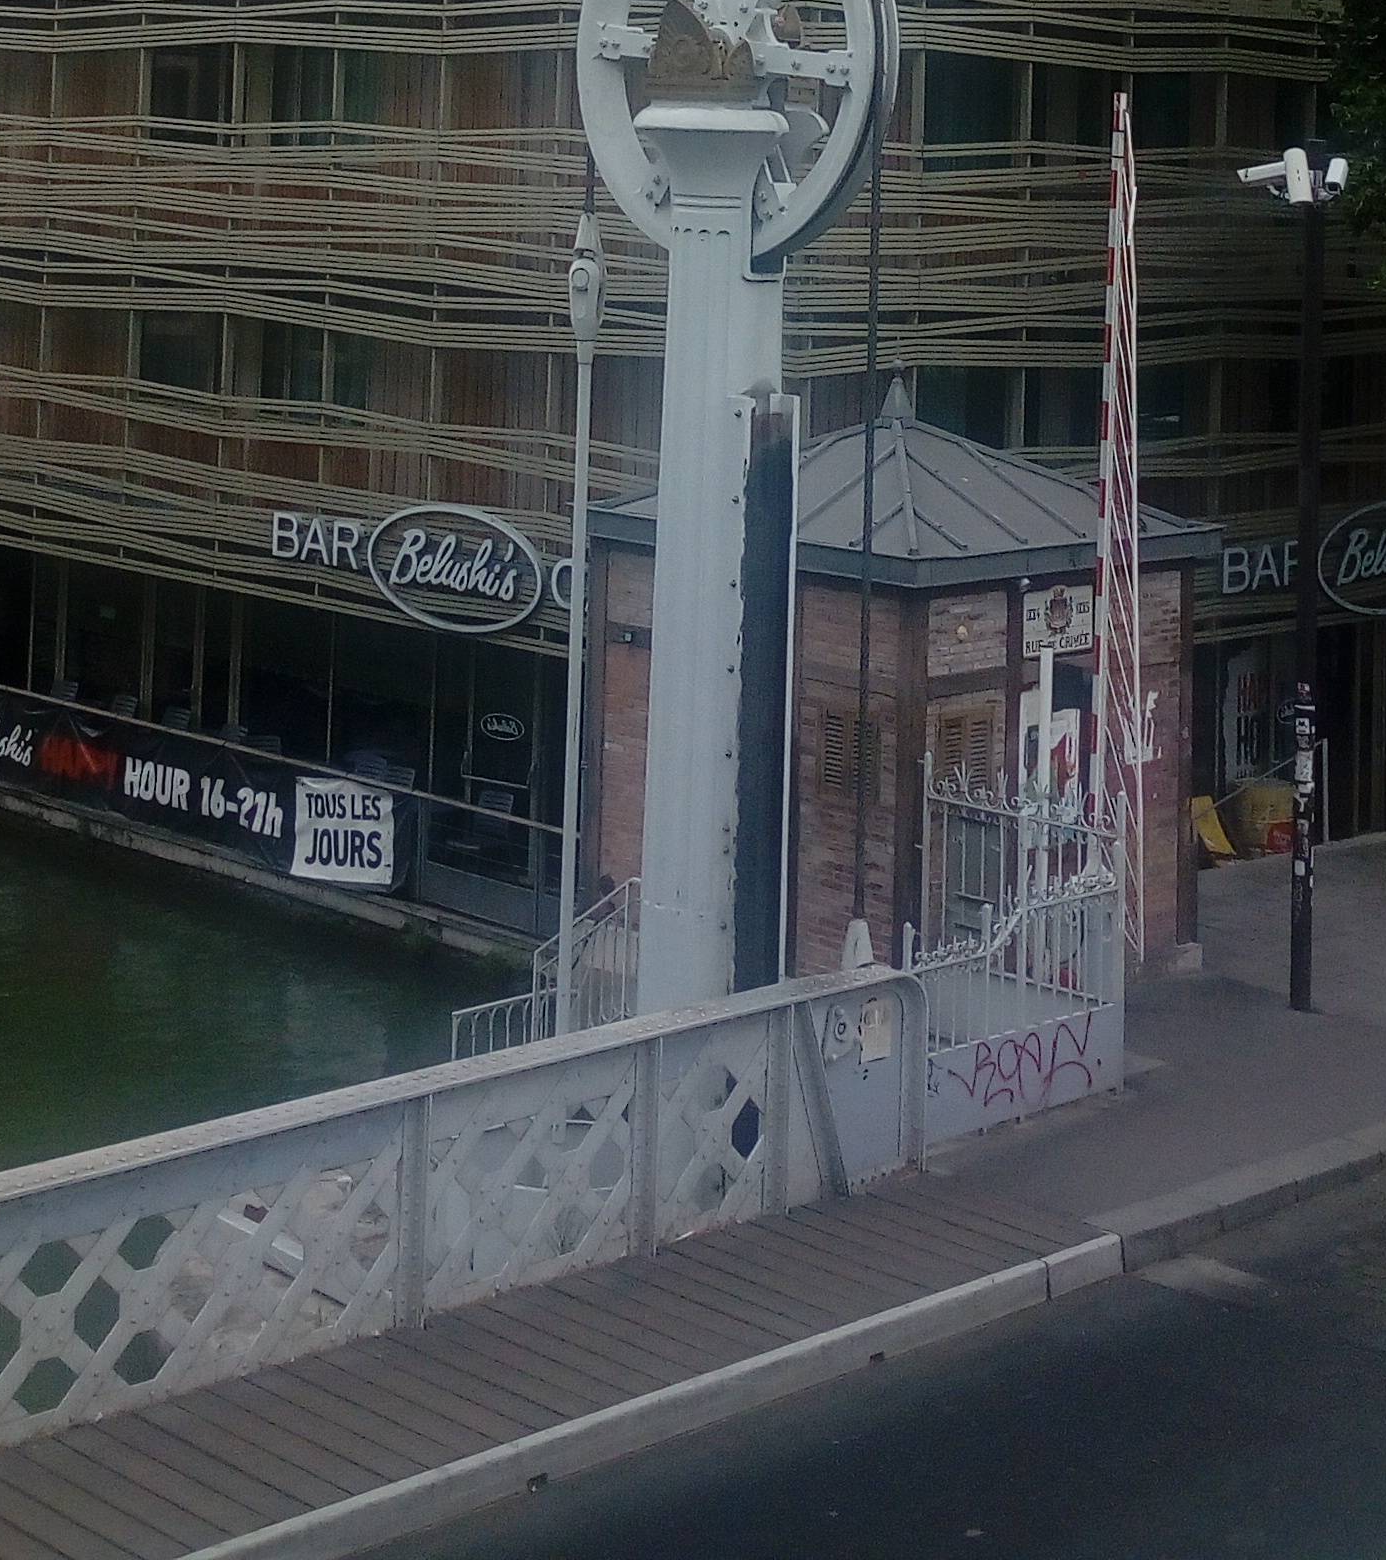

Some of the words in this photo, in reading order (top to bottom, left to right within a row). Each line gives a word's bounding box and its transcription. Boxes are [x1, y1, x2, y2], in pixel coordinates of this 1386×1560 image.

[271, 511, 360, 571] BAR
[389, 527, 518, 602] Belushi's
[123, 756, 191, 812] HOUR
[199, 775, 284, 839] 16-21h
[304, 792, 347, 820] TOUS
[350, 793, 382, 822] LES
[303, 826, 383, 870] JOURS
